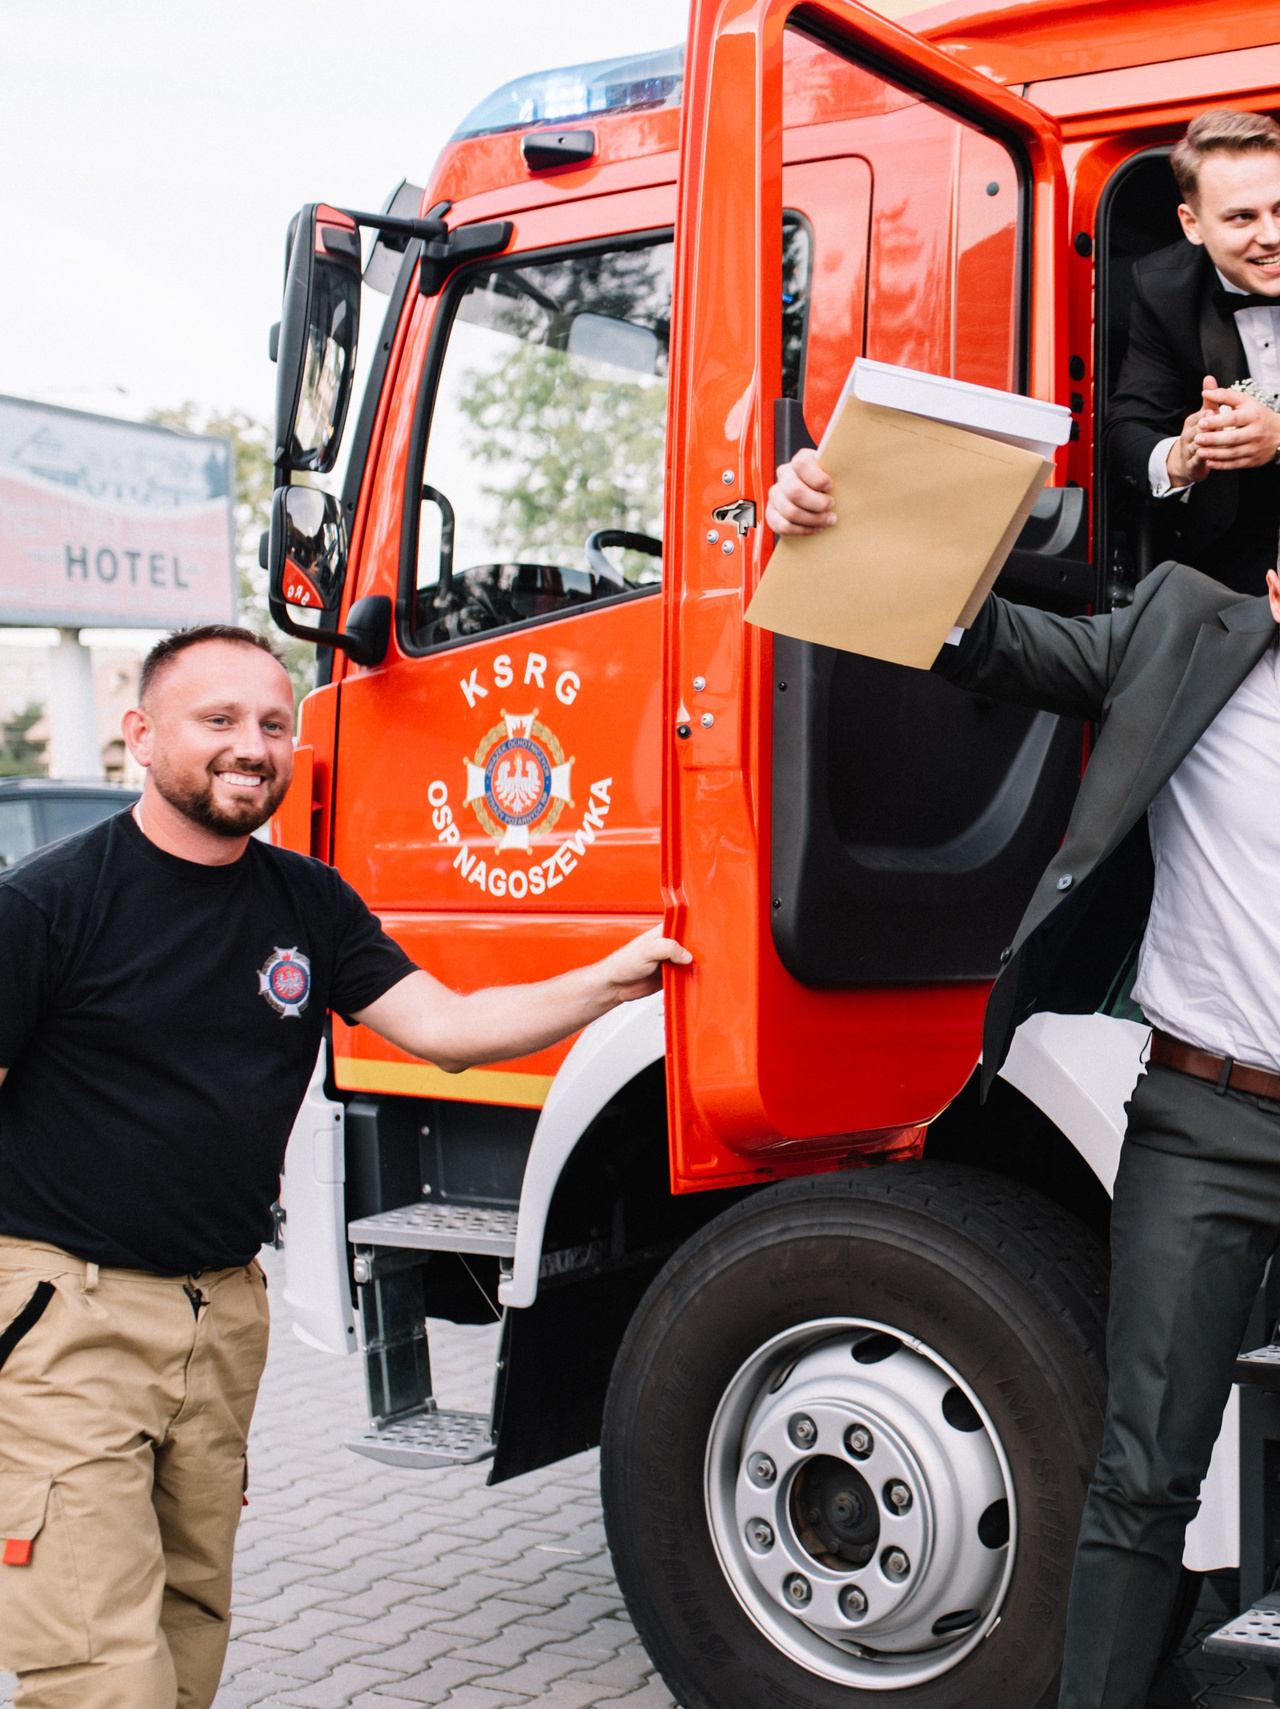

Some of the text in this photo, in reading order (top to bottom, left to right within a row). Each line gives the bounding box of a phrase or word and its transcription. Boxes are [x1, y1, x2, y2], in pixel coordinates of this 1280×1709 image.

[64, 544, 190, 588] HOTEL
[459, 651, 581, 708] KSRG
[427, 777, 613, 899] OSP NAGOSZEWKA
